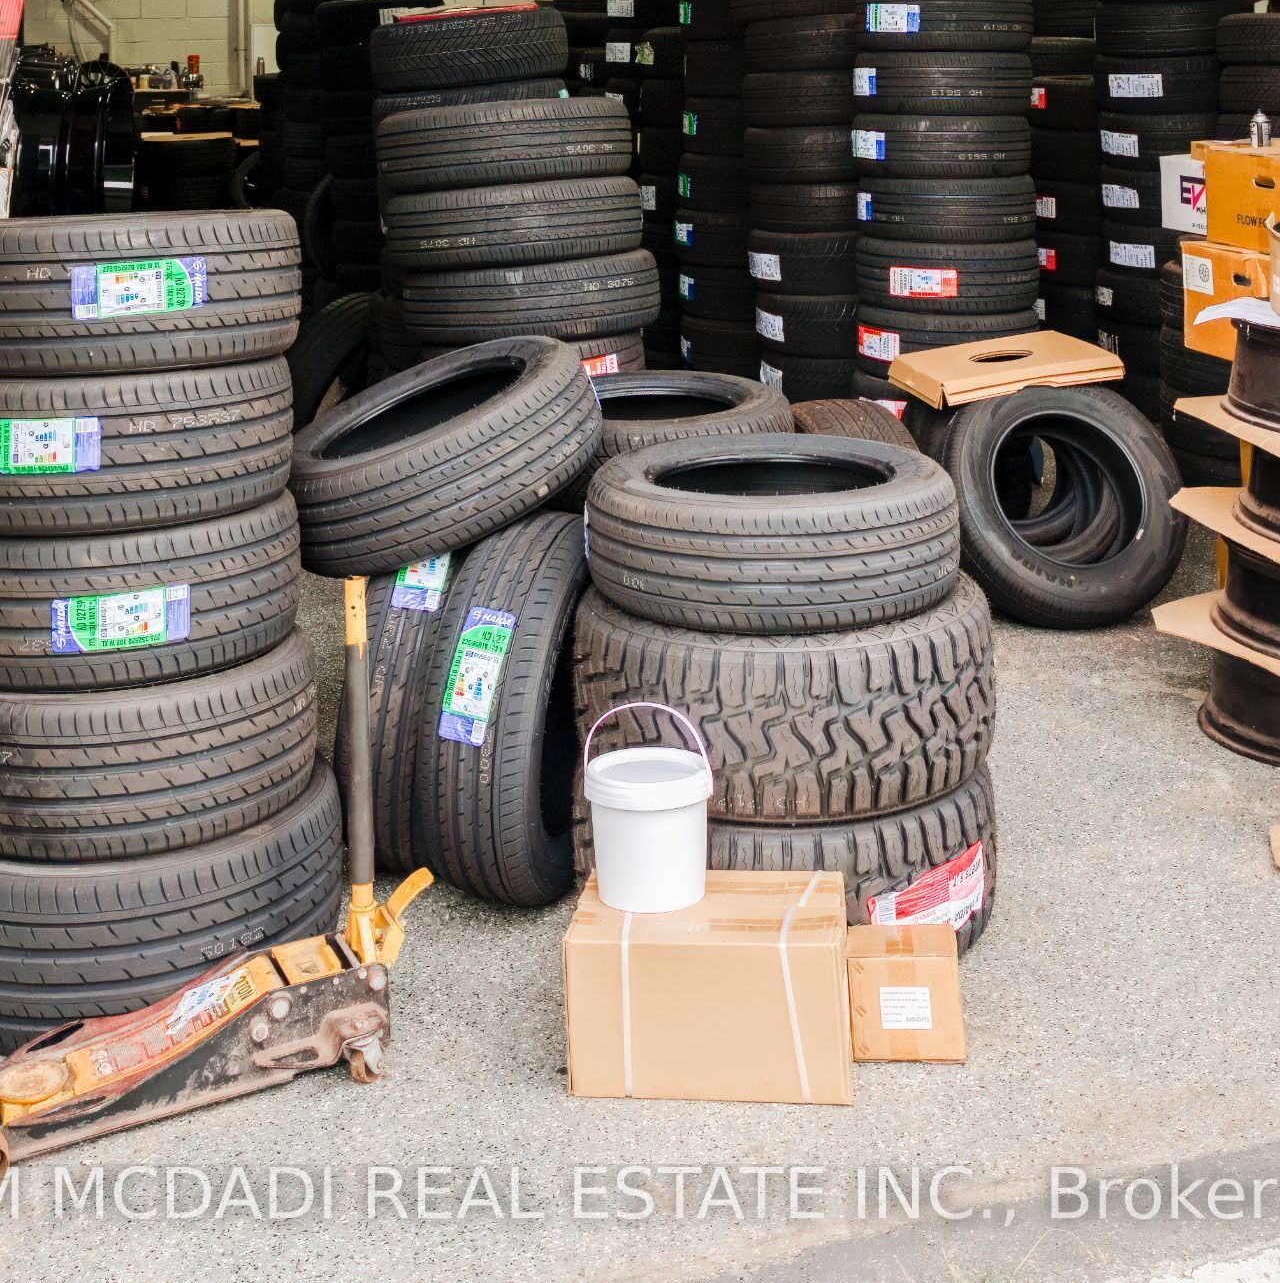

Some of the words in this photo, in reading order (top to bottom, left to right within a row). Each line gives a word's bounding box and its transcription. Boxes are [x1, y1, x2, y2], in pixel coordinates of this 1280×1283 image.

[1237, 214, 1257, 227] FLOW
[27, 267, 51, 280] HD
[129, 420, 155, 433] HD
